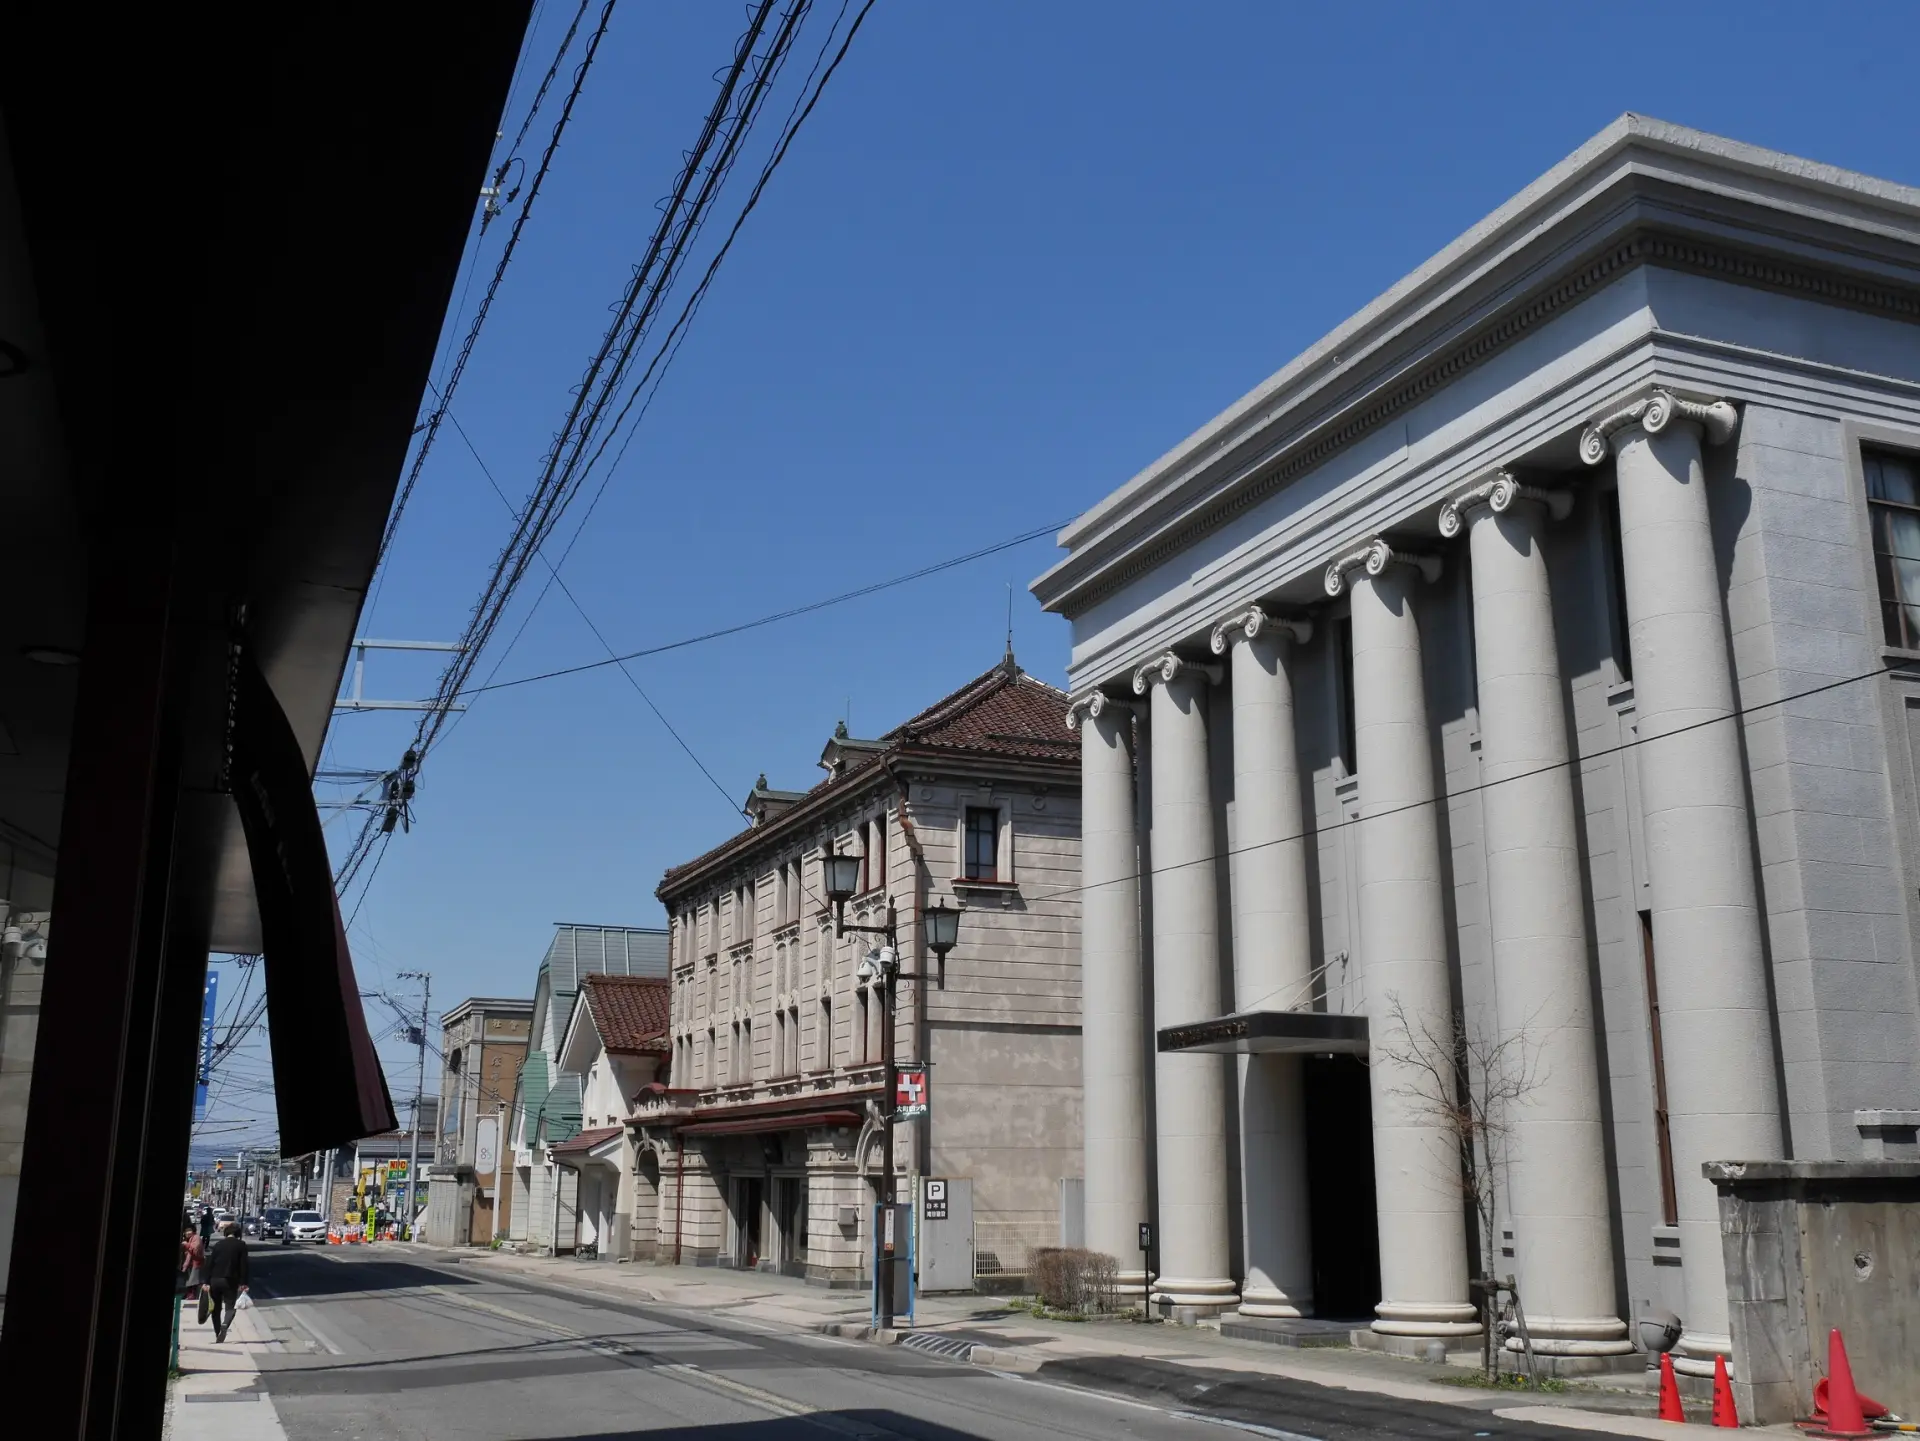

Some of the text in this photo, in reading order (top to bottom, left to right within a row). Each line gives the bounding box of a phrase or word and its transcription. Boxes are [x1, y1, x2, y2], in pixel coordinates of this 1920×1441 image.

[896, 1104, 927, 1112] 大町四ツ角
[931, 1184, 941, 1196] P
